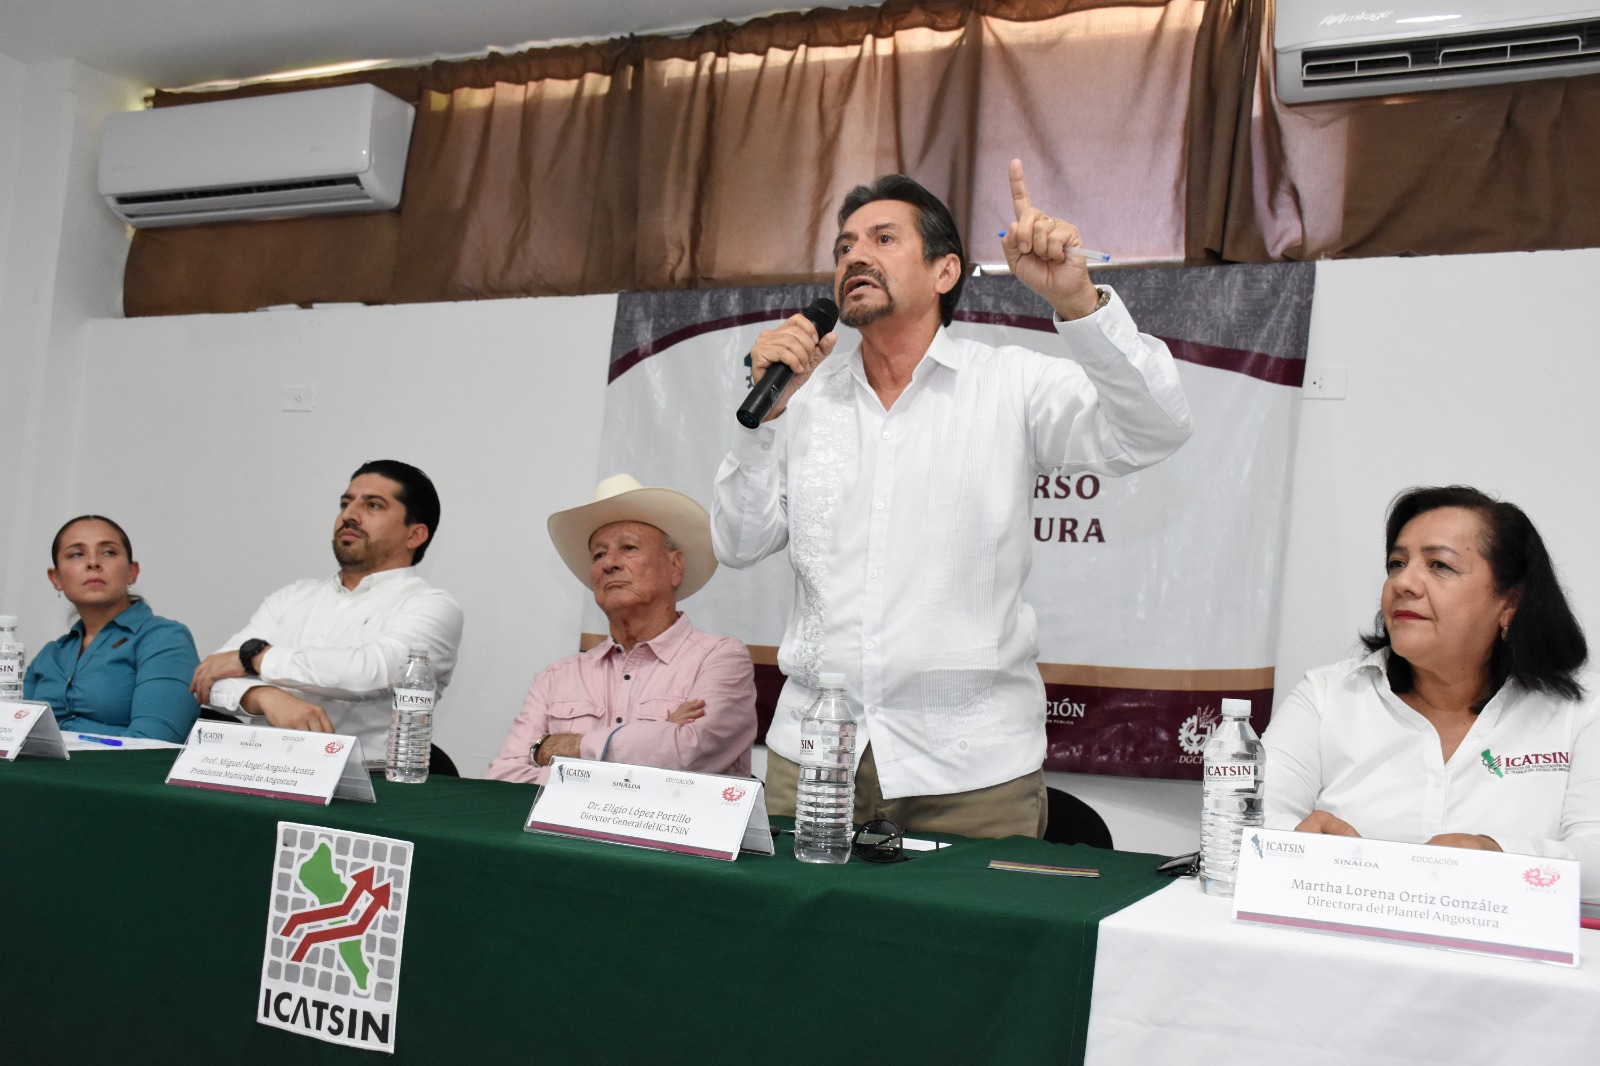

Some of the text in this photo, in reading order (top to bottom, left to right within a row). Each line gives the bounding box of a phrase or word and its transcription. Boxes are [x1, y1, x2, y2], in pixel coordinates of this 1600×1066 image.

[1034, 474, 1100, 500] RSO
[1034, 517, 1106, 543] URA
[0, 665, 14, 673] SIN
[399, 694, 432, 705] ICATSIN
[1046, 698, 1086, 718] CIÓN
[203, 731, 225, 740] ICATSIN
[801, 739, 814, 750] SIN
[201, 756, 316, 776] Prof. Miguel Ángel Angulo Acosta
[1505, 752, 1569, 767] ICATSIN
[190, 766, 298, 787] Presidente Municipal de Angostura
[566, 768, 592, 779] ICATSIN
[1205, 765, 1251, 776] ICATSIN
[612, 781, 641, 790] SINALOA
[586, 801, 692, 824] Dr. Eligio López Portillo
[580, 811, 689, 835] Director General del ICATSIN
[1266, 841, 1305, 854] ICATSIN
[1333, 858, 1380, 869] SINALOA
[1411, 855, 1459, 866] EDUCACIÓN
[1290, 878, 1509, 915] Martha Lorena Ortiz González
[1306, 895, 1500, 930] Directora del Plantel Angostura
[263, 988, 390, 1044] ICATSIN
